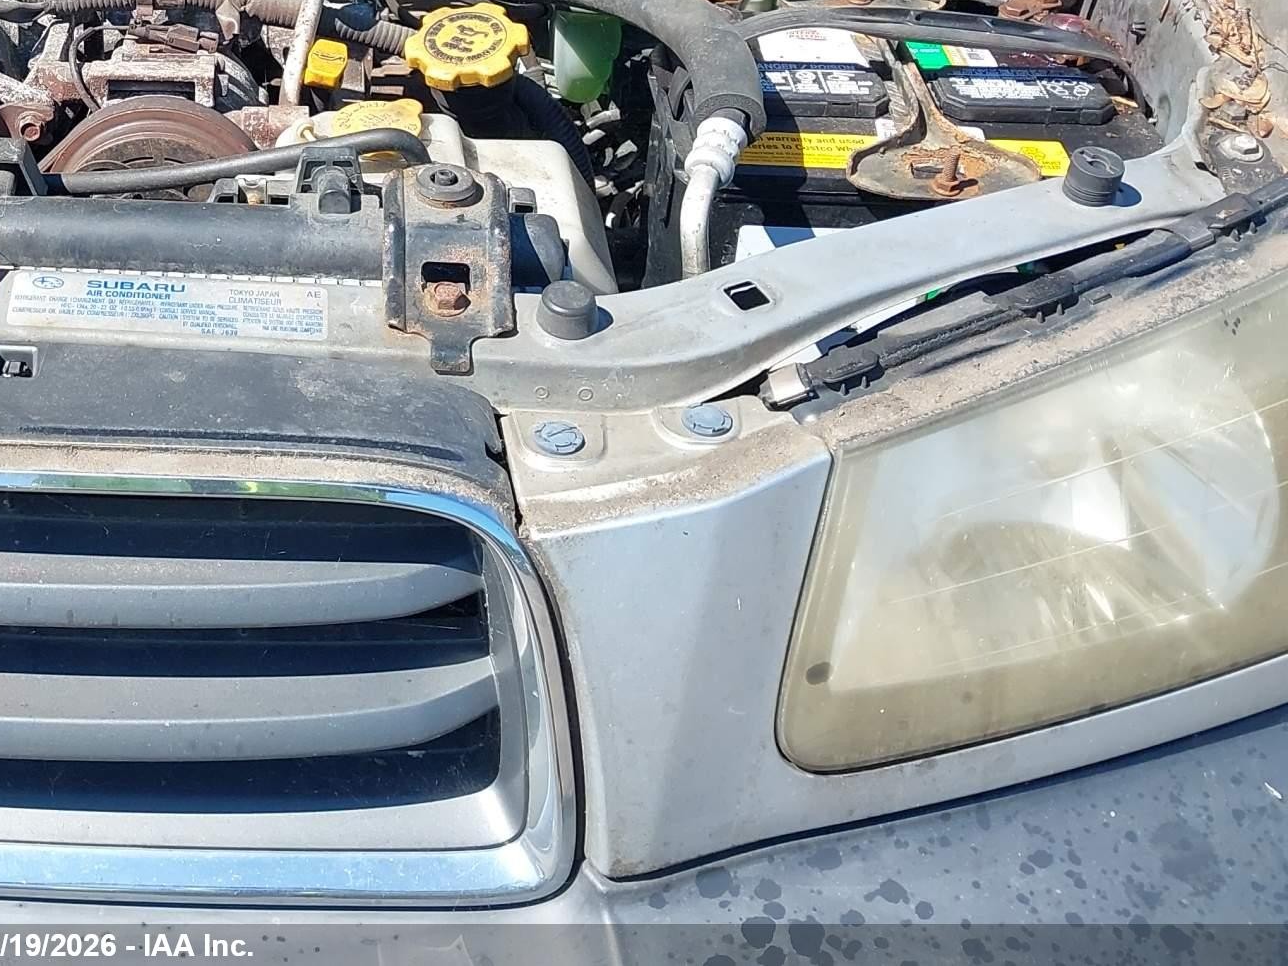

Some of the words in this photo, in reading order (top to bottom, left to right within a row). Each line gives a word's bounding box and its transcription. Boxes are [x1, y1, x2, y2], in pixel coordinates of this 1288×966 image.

[766, 136, 813, 146] warranty
[838, 138, 865, 146] used
[795, 144, 833, 152] Costco
[87, 279, 186, 293] SUBARU
[86, 289, 103, 297] AIR
[105, 291, 171, 300] CONDITIONER
[229, 289, 254, 297] TOKYO
[255, 290, 280, 298] JAPAN
[228, 297, 282, 305] CLIMATISEUR
